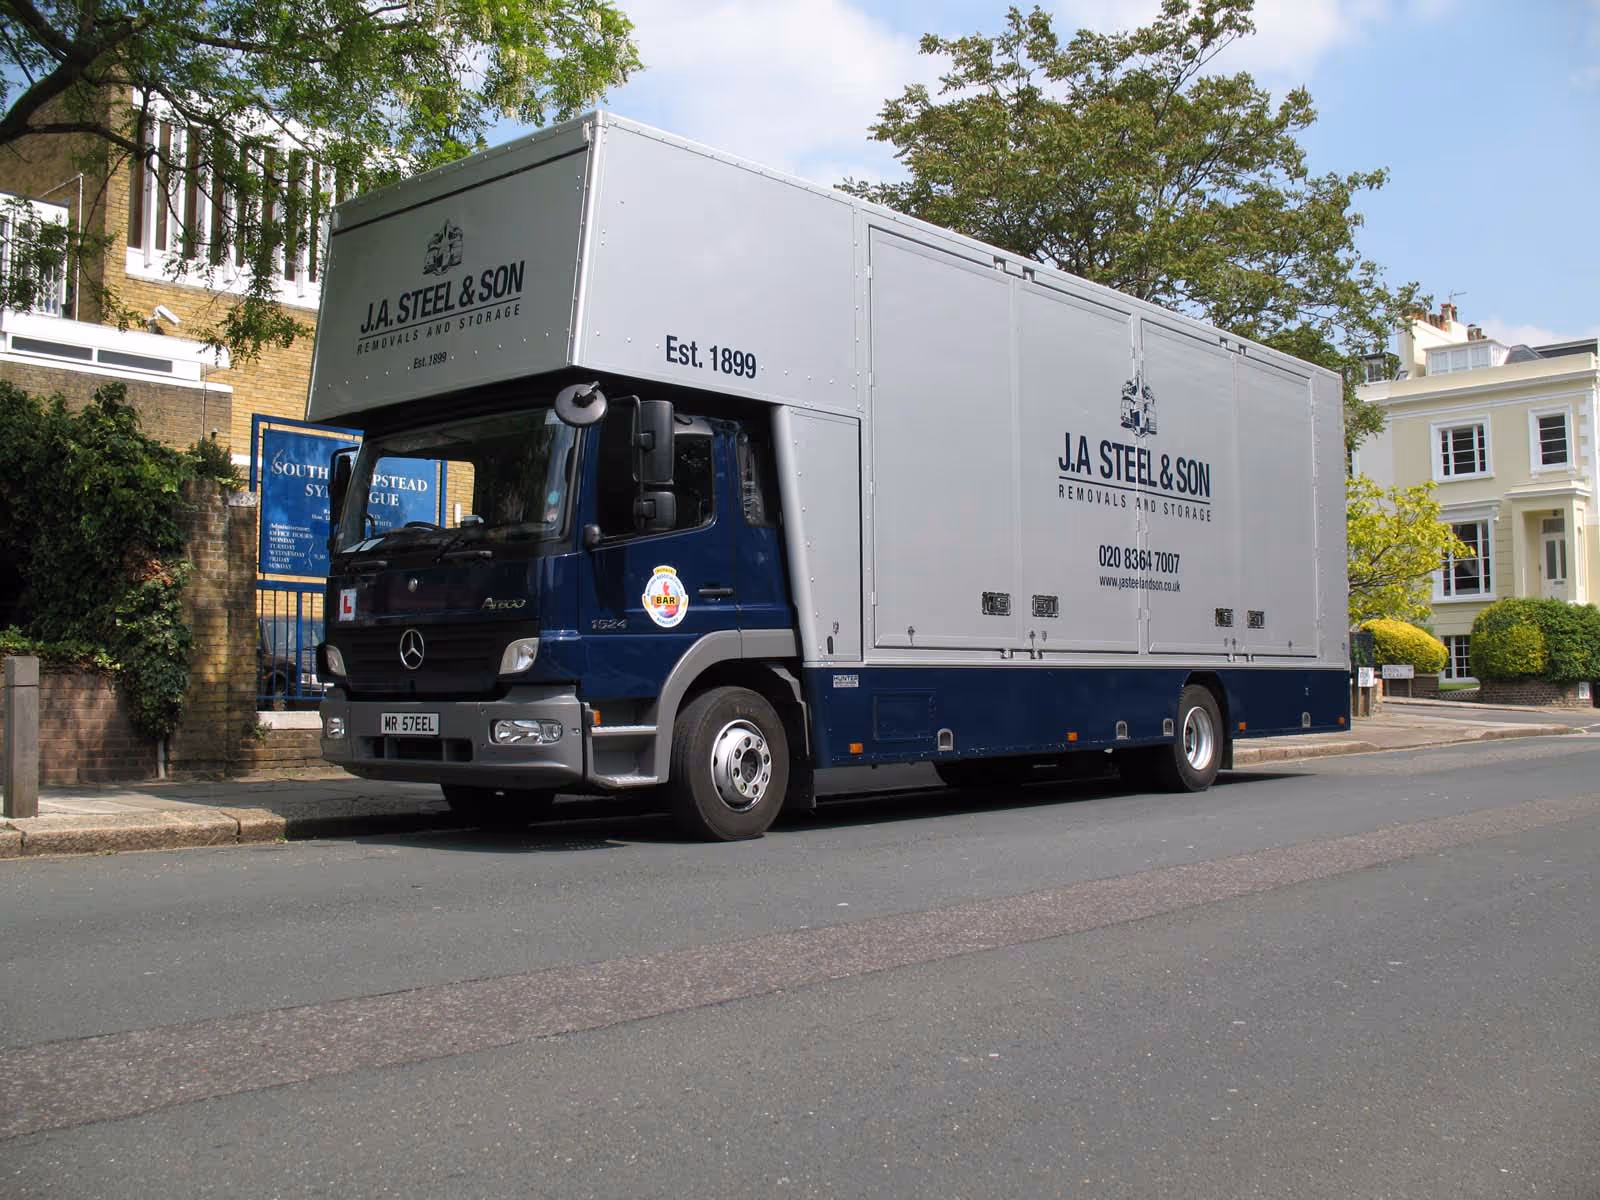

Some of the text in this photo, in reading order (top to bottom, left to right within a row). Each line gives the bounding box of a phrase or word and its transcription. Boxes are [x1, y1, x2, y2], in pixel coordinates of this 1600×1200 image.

[360, 260, 526, 334] J.A. STEEL & SON
[356, 303, 520, 356] REMOVALS AND STORAGE
[413, 352, 448, 369] Est. 1899
[666, 334, 757, 379] Est. 1899
[272, 461, 428, 492] SOUTH PSTEAD
[1058, 432, 1211, 498] J.A STEEL & SON
[1059, 484, 1212, 522] REMOVALS AND STORAGE
[1099, 545, 1180, 574] 020 8364 7007
[1099, 576, 1181, 592] www.jasteelandson.co.uk
[343, 595, 353, 614] L
[656, 596, 676, 605] BAR
[591, 619, 628, 630] 1524
[384, 714, 434, 732] MR 57EEL
